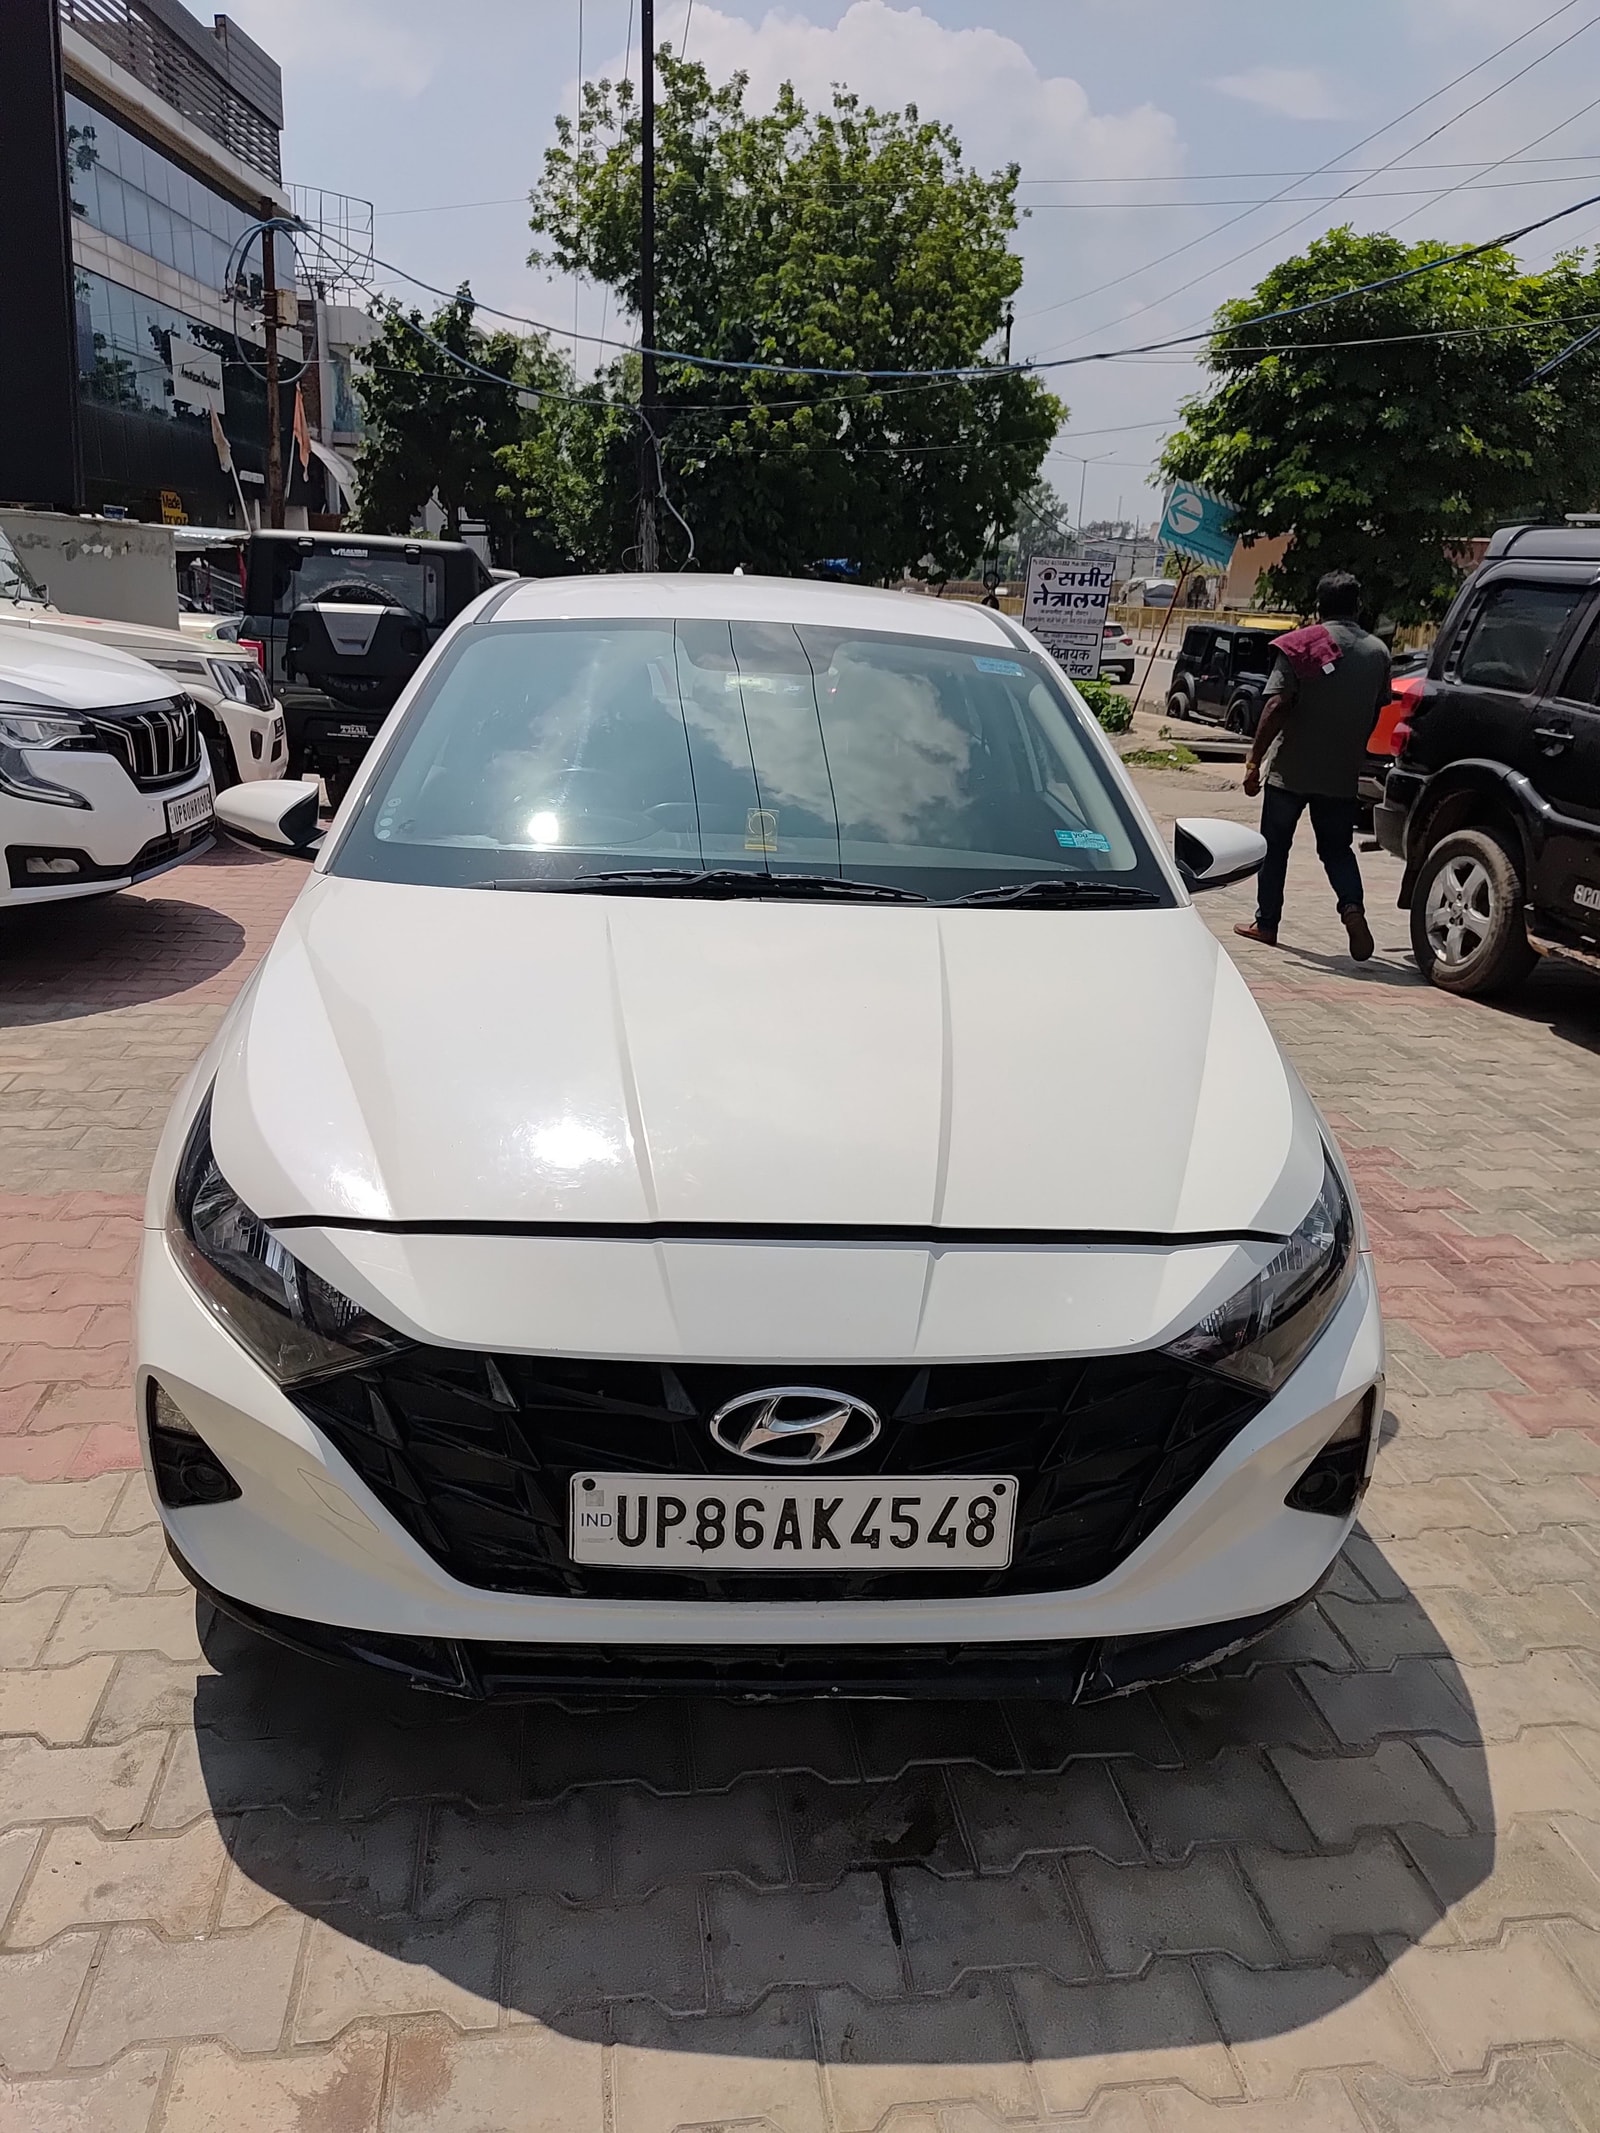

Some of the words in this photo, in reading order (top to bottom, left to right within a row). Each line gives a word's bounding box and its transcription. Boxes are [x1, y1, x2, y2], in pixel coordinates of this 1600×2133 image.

[1058, 567, 1113, 588] समीर
[1033, 583, 1109, 609] नेत्रालय
[581, 1513, 613, 1527] IND
[617, 1495, 997, 1550] UP86AK4548
